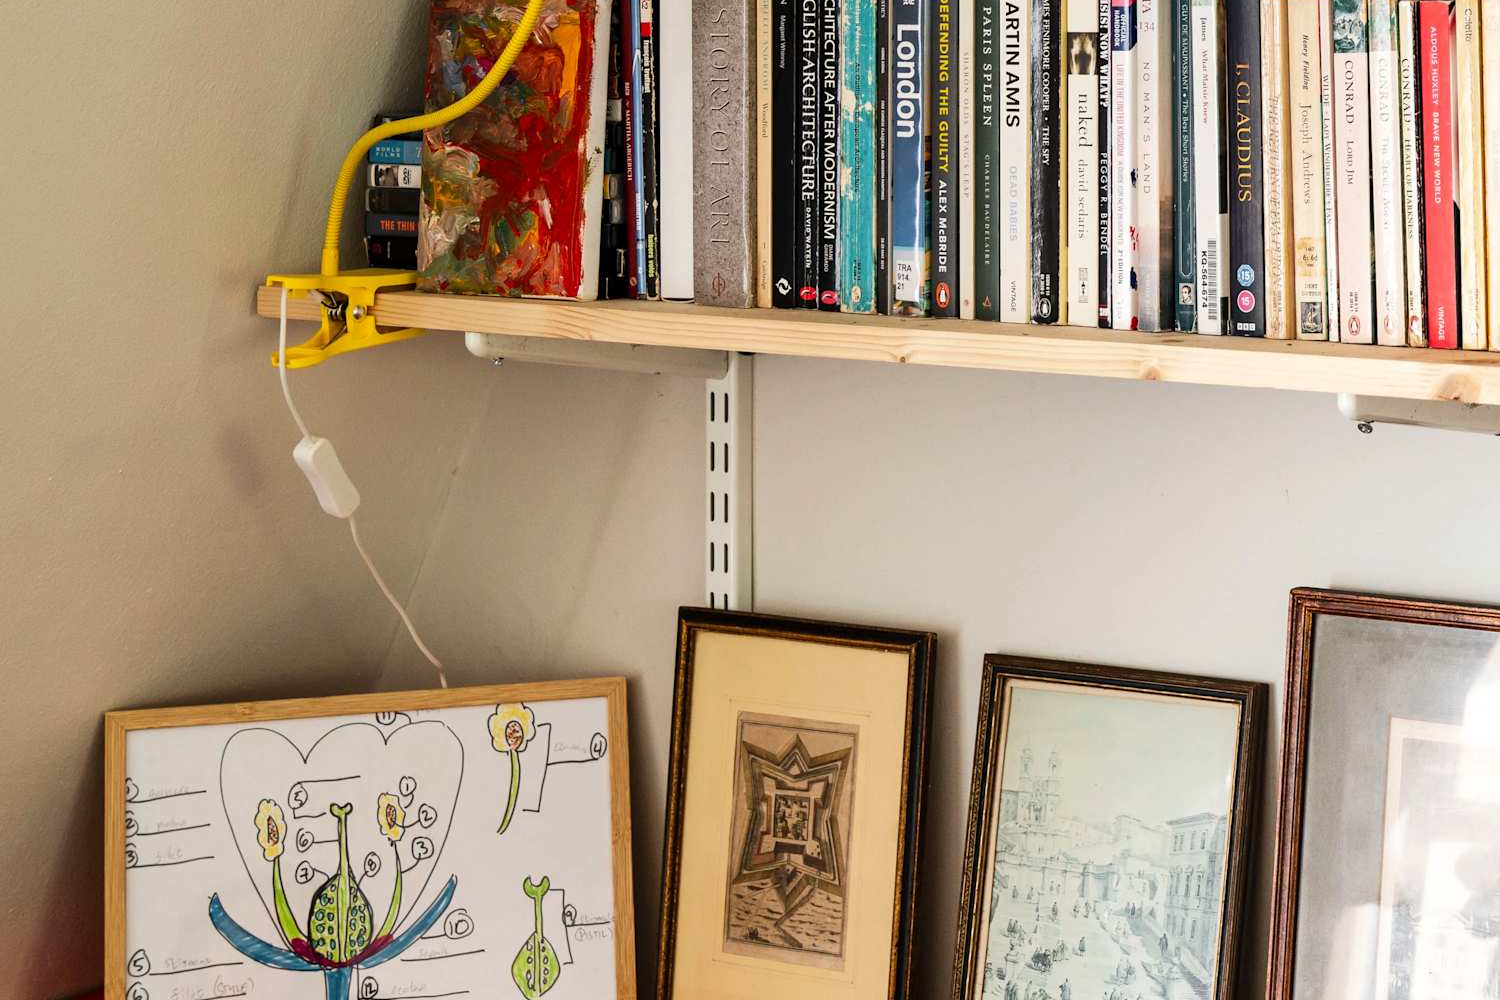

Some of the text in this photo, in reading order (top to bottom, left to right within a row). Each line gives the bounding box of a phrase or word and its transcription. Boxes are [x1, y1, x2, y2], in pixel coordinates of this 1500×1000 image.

[895, 22, 921, 139] London
[938, 86, 949, 115] THE
[983, 6, 993, 126] PARIS SPLEEN
[1005, 68, 1021, 129] AMIS
[1344, 59, 1355, 125] CONRAD
[1429, 26, 1440, 105] ALDOUS HUXLEY
[801, 58, 815, 202] ARCHITECTURE
[937, 119, 949, 173] GUILTY
[1078, 93, 1094, 149] naked
[1236, 79, 1252, 204] CLAUDIUS
[379, 220, 416, 231] THE THIN
[822, 139, 834, 241] MODERNISM
[1100, 152, 1109, 256] PEGGY BENDEL
[1433, 168, 1443, 204] WORLD
[937, 179, 948, 274] ALEX McBRIDE
